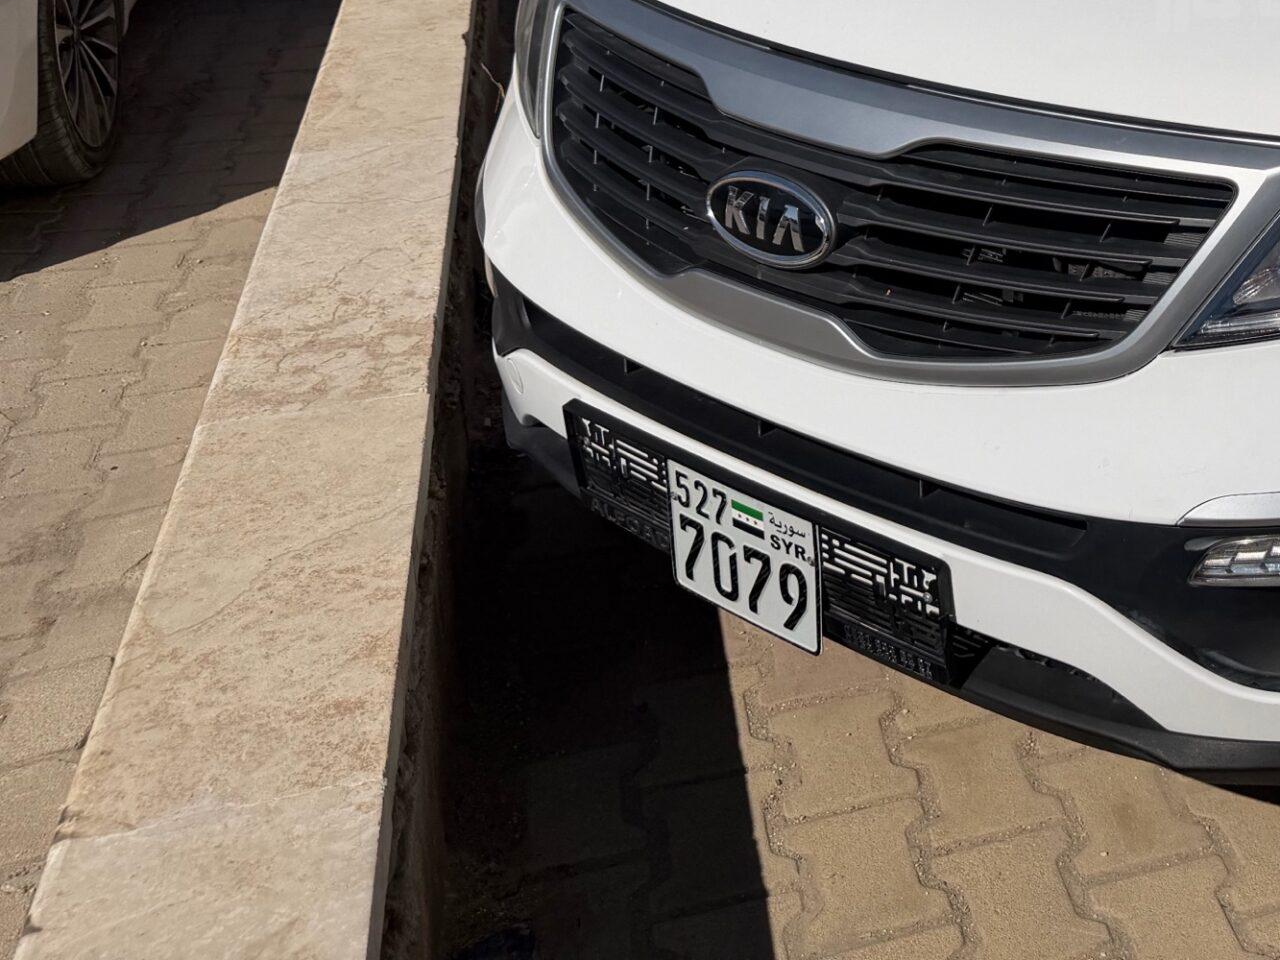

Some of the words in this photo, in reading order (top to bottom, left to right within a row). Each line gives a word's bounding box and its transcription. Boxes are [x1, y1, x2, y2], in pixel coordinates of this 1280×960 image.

[725, 186, 805, 252] KIA
[675, 470, 727, 526] 527
[768, 511, 806, 538] سورية
[679, 513, 808, 631] 7079
[770, 534, 807, 561] SYR
